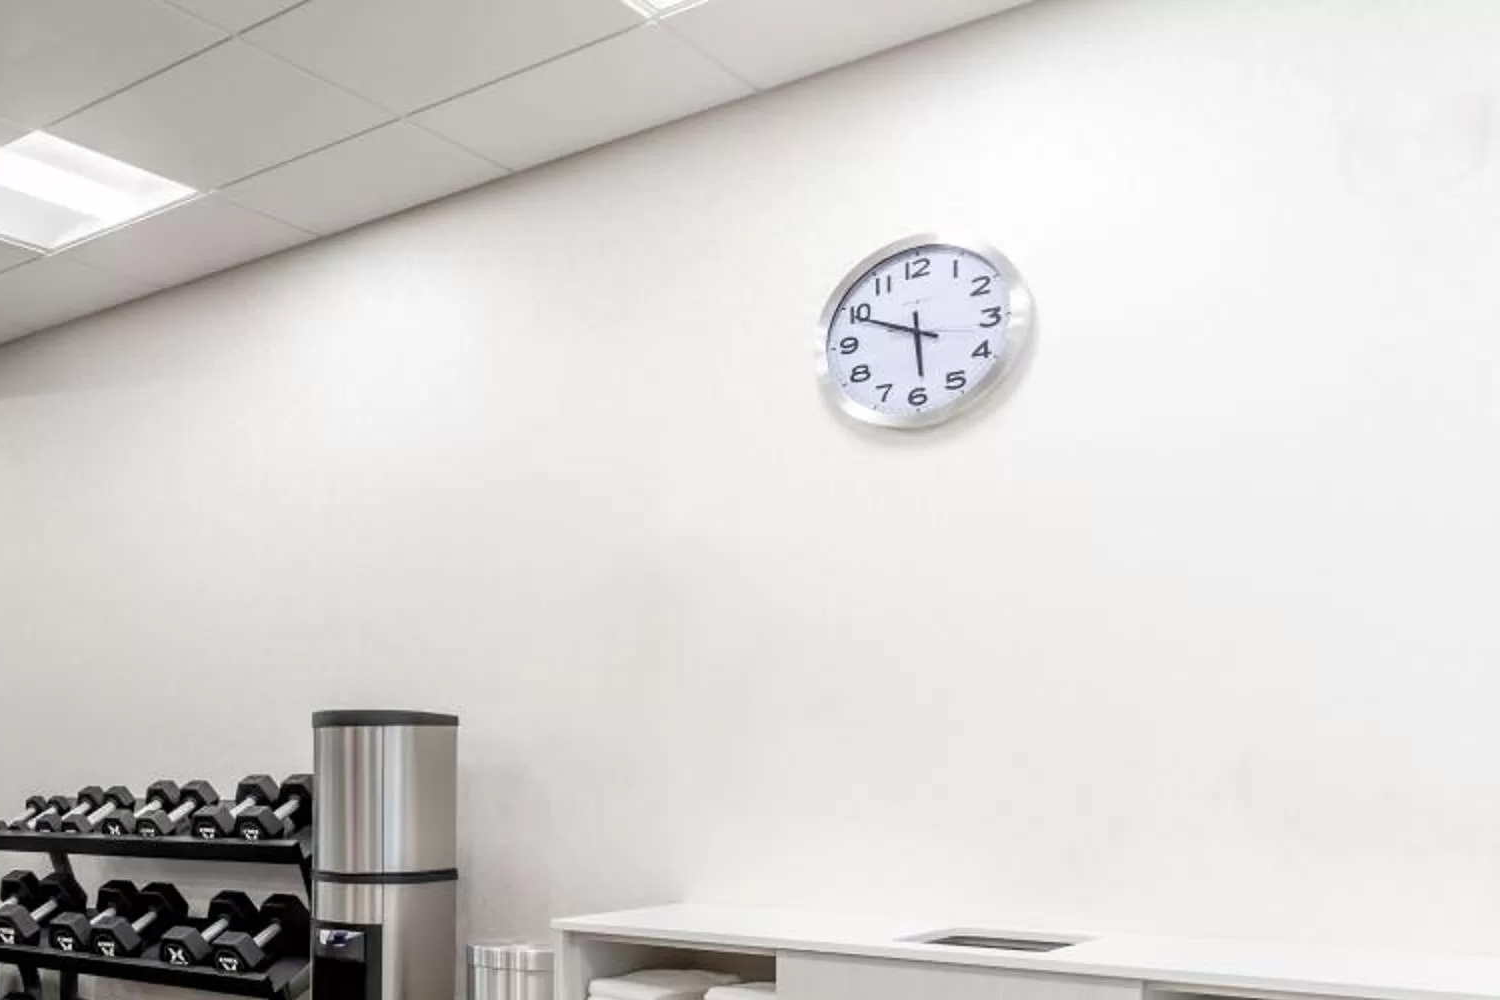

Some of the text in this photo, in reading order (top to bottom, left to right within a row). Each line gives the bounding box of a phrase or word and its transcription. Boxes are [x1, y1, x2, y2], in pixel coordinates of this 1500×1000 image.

[904, 257, 931, 280] 12
[952, 259, 959, 279] 1
[874, 275, 892, 297] 11
[969, 275, 992, 297] 2
[849, 303, 872, 325] 10
[979, 305, 1002, 328] 3
[839, 336, 860, 355] 9
[971, 340, 992, 359] 4
[849, 364, 872, 383] 8
[944, 370, 967, 391] 5
[875, 383, 894, 403] 7
[907, 387, 929, 407] 6
